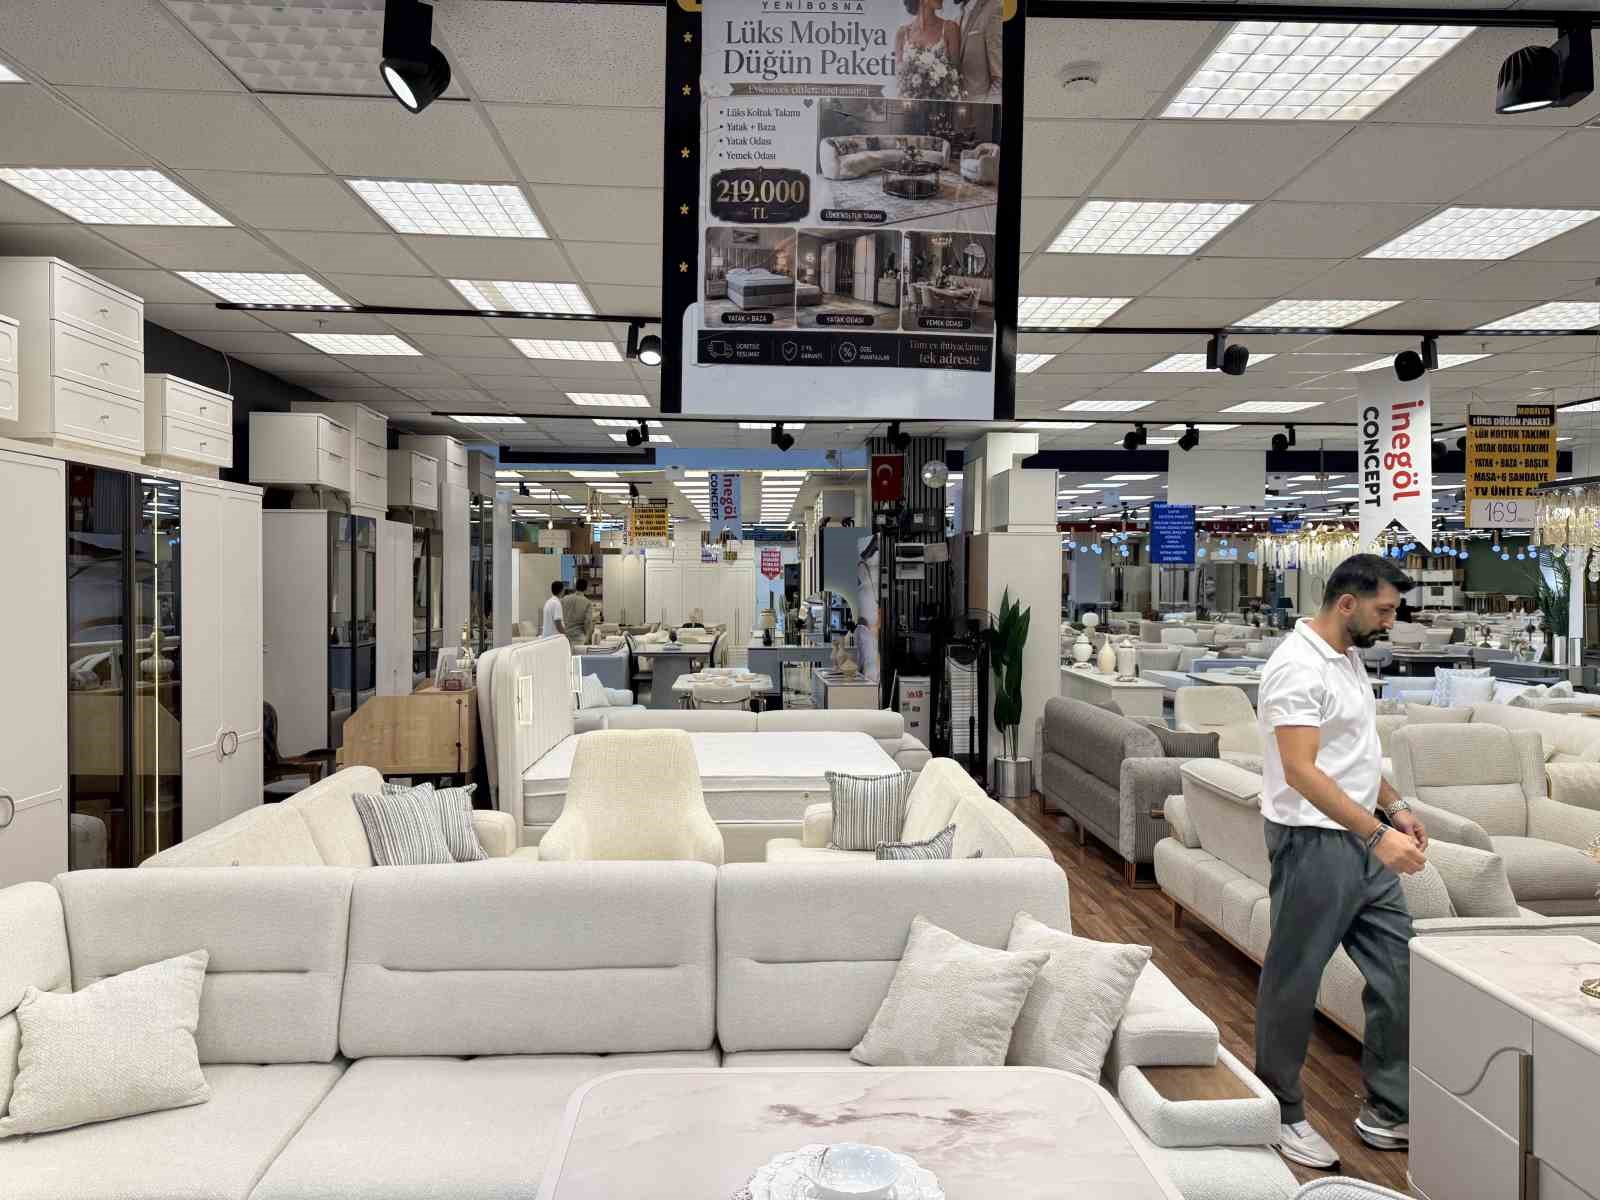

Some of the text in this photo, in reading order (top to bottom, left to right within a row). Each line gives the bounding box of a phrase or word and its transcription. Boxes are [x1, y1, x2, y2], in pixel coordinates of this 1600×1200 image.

[726, 20, 888, 51] Lüks Mobilya
[723, 50, 896, 80] Düğün Paketi
[726, 136, 748, 146] Yatak
[726, 151, 752, 161] Yemek
[717, 179, 805, 204] 219.000
[751, 207, 768, 220] TL
[1362, 406, 1381, 507] CONCEPT
[1383, 400, 1424, 503] inegöl
[710, 473, 719, 520] CONCEPT
[1474, 486, 1488, 496] TV
[1490, 485, 1524, 496] ÜNİTE
[1484, 502, 1518, 523] 169
